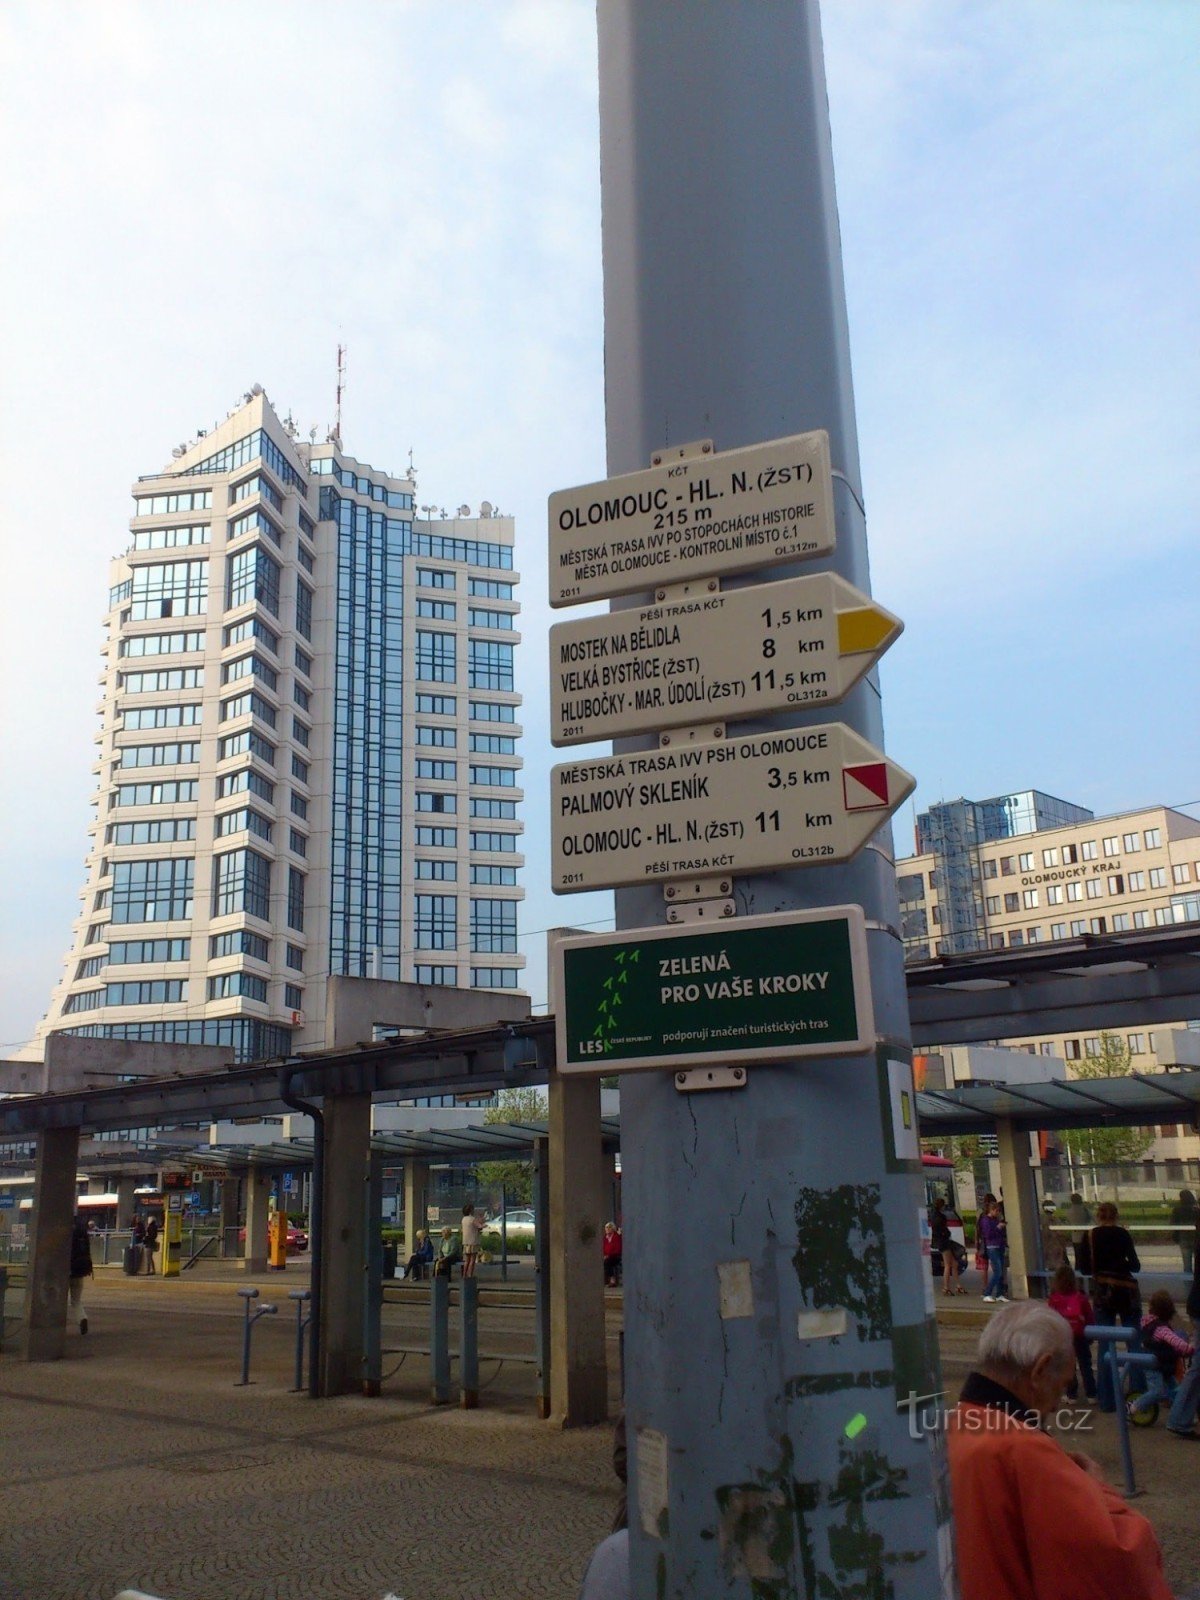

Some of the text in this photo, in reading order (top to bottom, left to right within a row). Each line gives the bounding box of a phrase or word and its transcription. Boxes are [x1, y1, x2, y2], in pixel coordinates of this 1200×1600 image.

[668, 466, 688, 478] KČT
[558, 489, 668, 531] OLOMOUC
[689, 479, 724, 504] HL.
[732, 471, 753, 493] N.
[757, 463, 813, 492] (ŽST)
[654, 506, 712, 530] 215 m
[560, 503, 815, 566] MĚSTSKÁ TRASA IVV PO STOPOCHÁCH HISTORIE
[774, 540, 818, 556] OL312m
[575, 560, 609, 581] MĚSTA
[611, 550, 671, 572] OLOMOUCE
[680, 536, 744, 560] KONTROLNÍ
[746, 527, 780, 545] MÍSTO
[560, 587, 581, 598] 2011
[640, 598, 725, 621] PĚŠÍ TRASA KČT
[560, 608, 822, 663] MOSTEK NA BĚLIDLA 1,5 km
[561, 638, 824, 693] VELKÁ BYSTŘICE (ŽST) 8 km
[561, 691, 625, 722] HLUBOČKY
[635, 686, 665, 711] MAR.
[668, 676, 705, 703] ÚDOLÍ
[708, 680, 746, 700] (ŽST)
[751, 668, 794, 692] 11,5
[800, 669, 826, 685] km
[787, 689, 828, 702] OL312a
[563, 725, 584, 736] 2011
[560, 734, 828, 785] MĚSTSKÁ TRASA IVV PSH OLOMOUCE
[561, 767, 830, 817] PALMOVÝ SKLENÍK 3,5 km
[562, 827, 642, 856] OLOMOUC
[657, 822, 682, 845] HL.
[686, 819, 702, 840] N.
[704, 821, 744, 842] (ŽST)
[755, 810, 780, 833] 11
[805, 812, 832, 828] km
[645, 845, 834, 874] PĚŠÍ TRASA KČT OL312b
[1021, 861, 1121, 885] OLOMOUCKÝ KRAJ
[562, 873, 584, 884] 2011
[659, 950, 730, 977] ZELENÁ
[661, 972, 829, 1004] PRO VAŠE KROKY
[662, 1018, 829, 1044] podporují značení turistických tras
